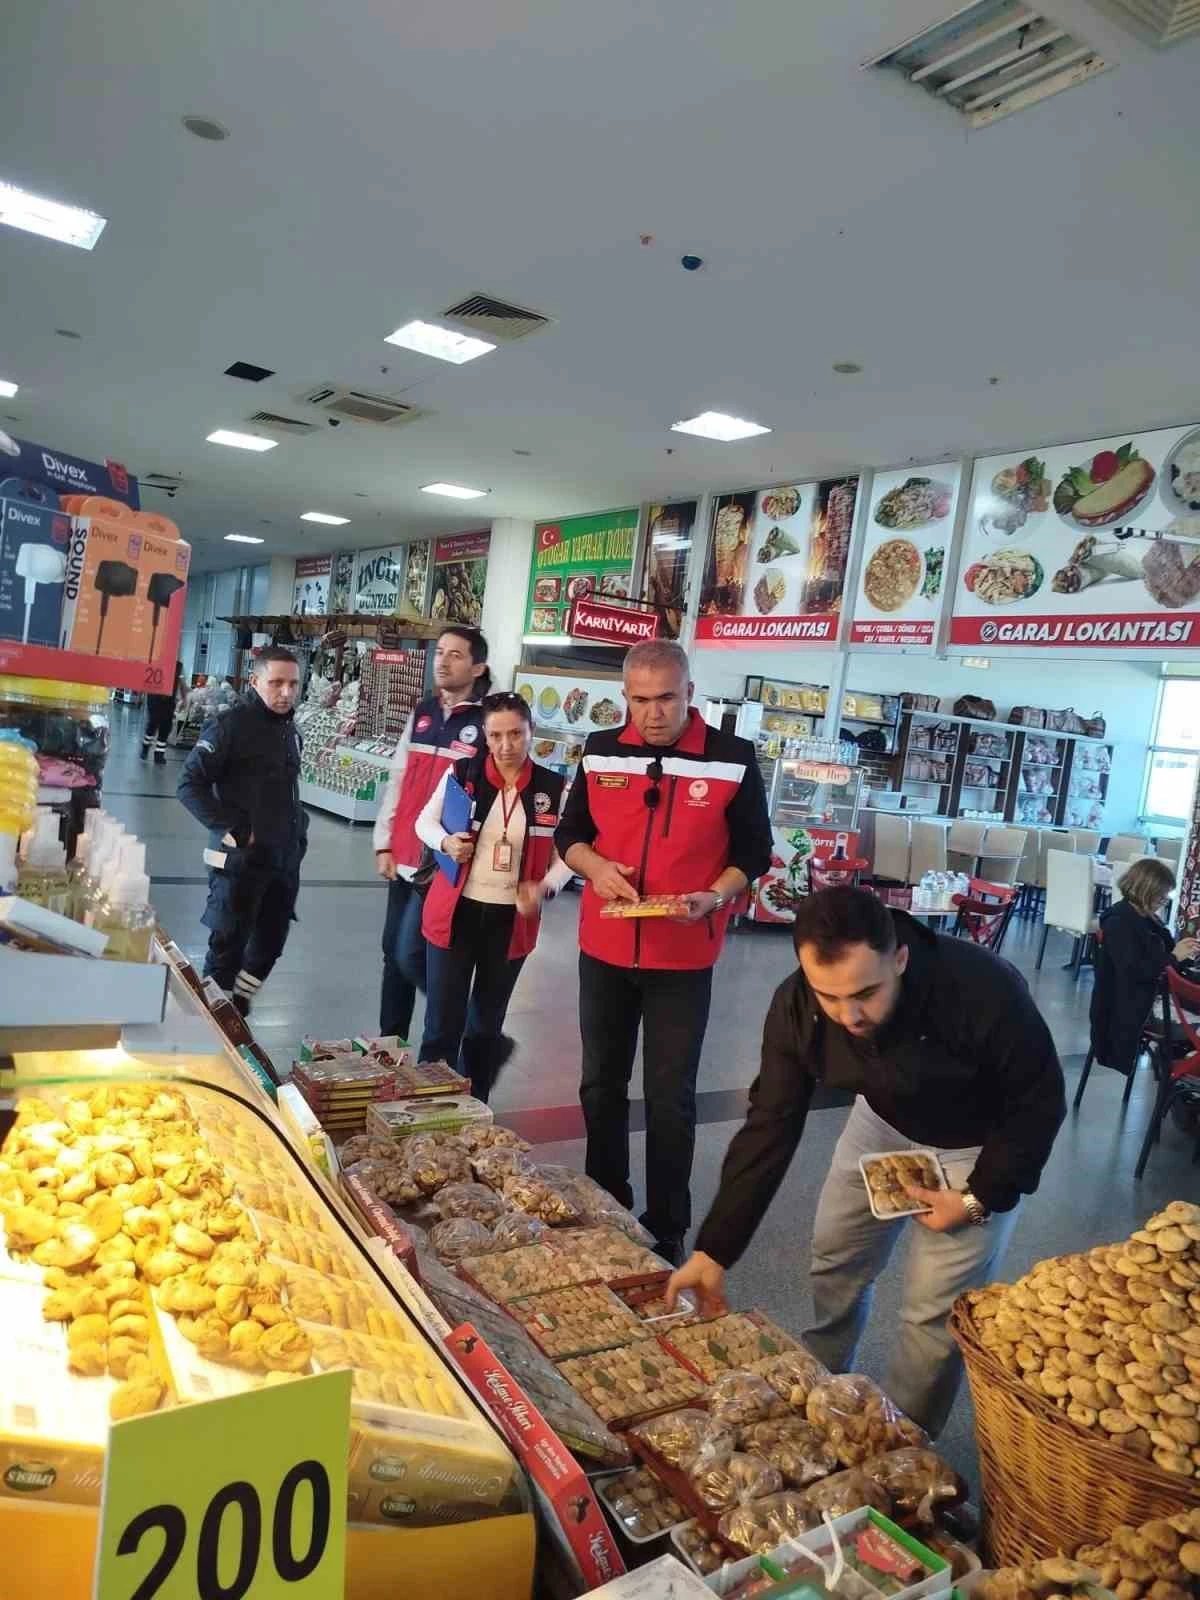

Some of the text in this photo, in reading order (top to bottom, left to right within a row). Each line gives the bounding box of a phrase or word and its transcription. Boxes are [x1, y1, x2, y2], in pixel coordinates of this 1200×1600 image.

[42, 452, 88, 482] Divex
[8, 507, 41, 526] Divex
[91, 526, 118, 543] Divex
[143, 541, 168, 557] Divex
[66, 528, 88, 600] SOUND
[723, 621, 830, 637] GARAJ LOKANTASI
[998, 621, 1193, 641] GARAJ LOKANTASI
[144, 667, 164, 685] 20
[116, 1460, 331, 1600] 200
